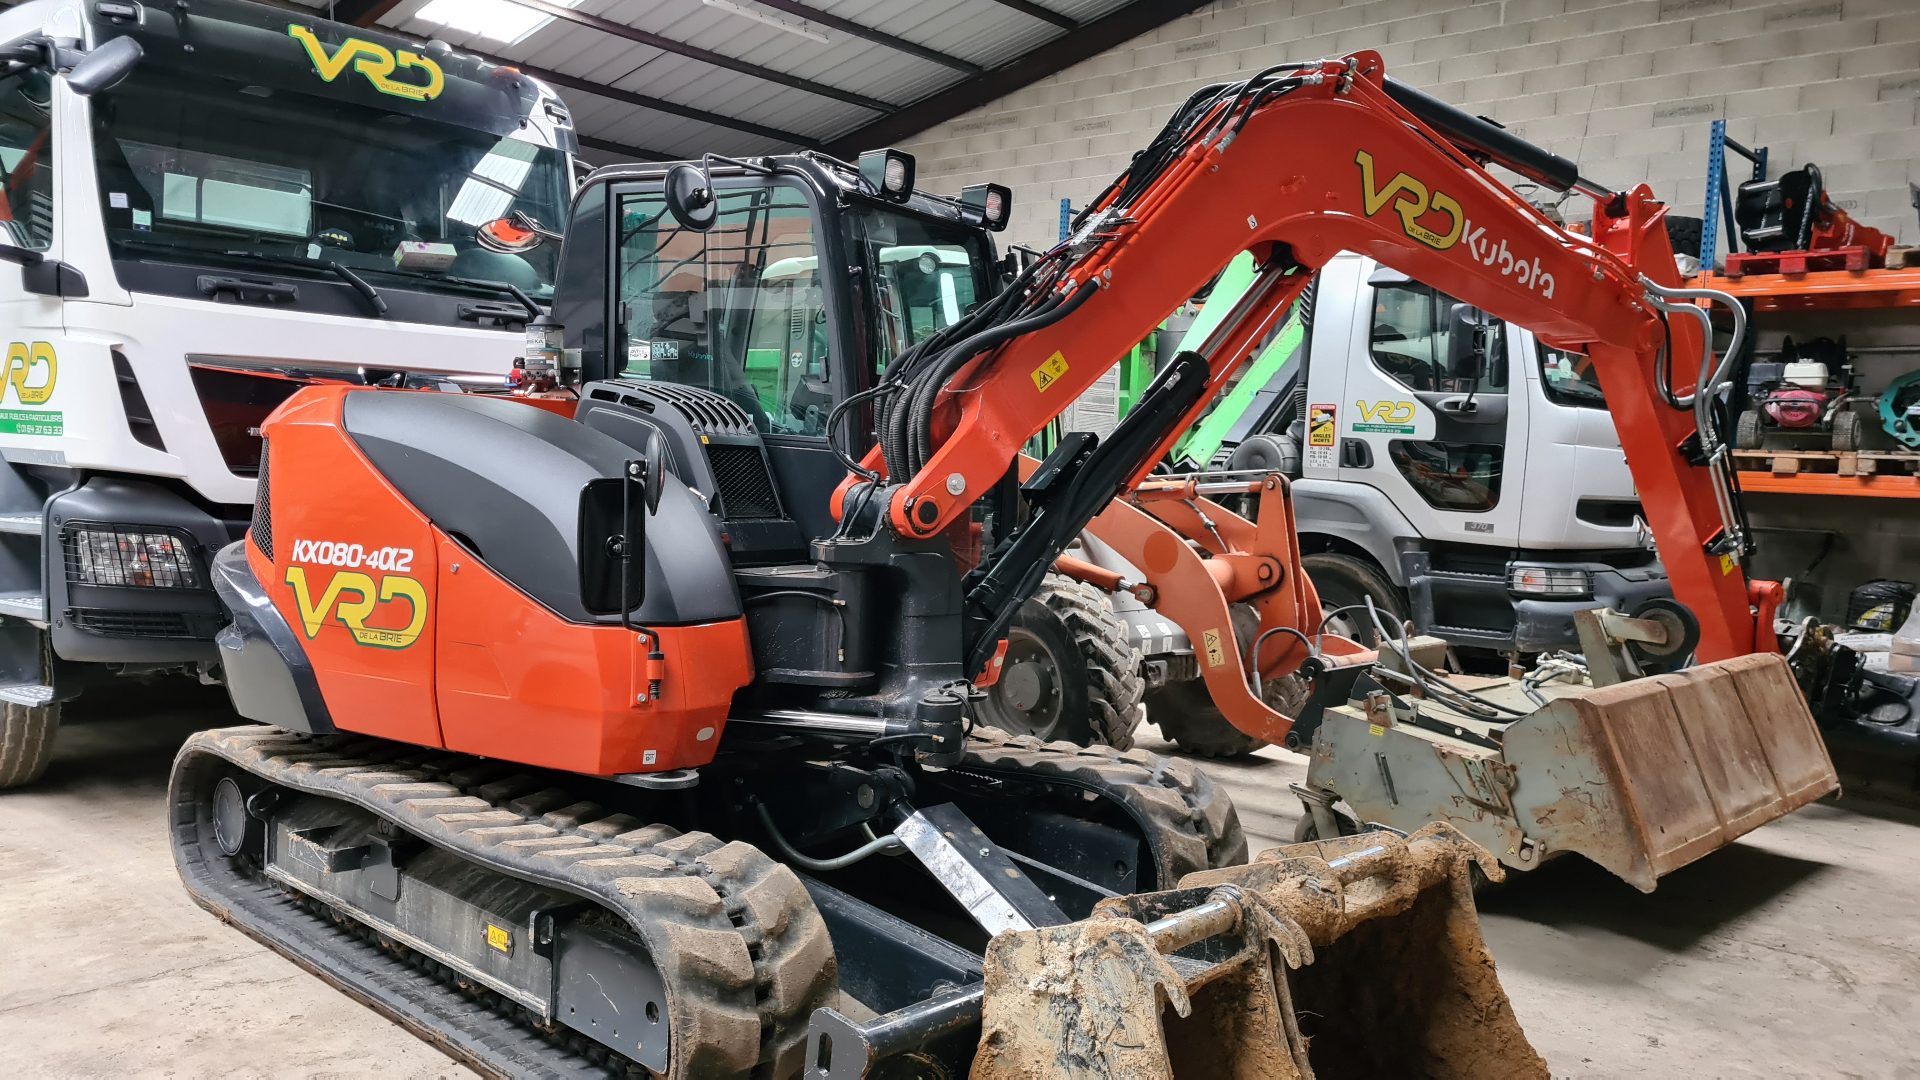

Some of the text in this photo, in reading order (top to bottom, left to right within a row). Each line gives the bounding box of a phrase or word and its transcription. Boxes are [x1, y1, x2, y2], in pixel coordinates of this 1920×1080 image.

[288, 24, 445, 101] VRD
[380, 82, 391, 90] DE
[401, 86, 424, 97] BRIE
[1354, 150, 1464, 250] VRD
[1423, 232, 1442, 246] BRIE
[1461, 219, 1555, 299] Kubota
[1356, 400, 1415, 423] VRD
[35, 425, 43, 434] 37
[43, 426, 52, 434] 63
[53, 426, 62, 435] 33
[1471, 522, 1488, 530] 370
[284, 565, 428, 650] VRD
[379, 632, 402, 643] BRIE
